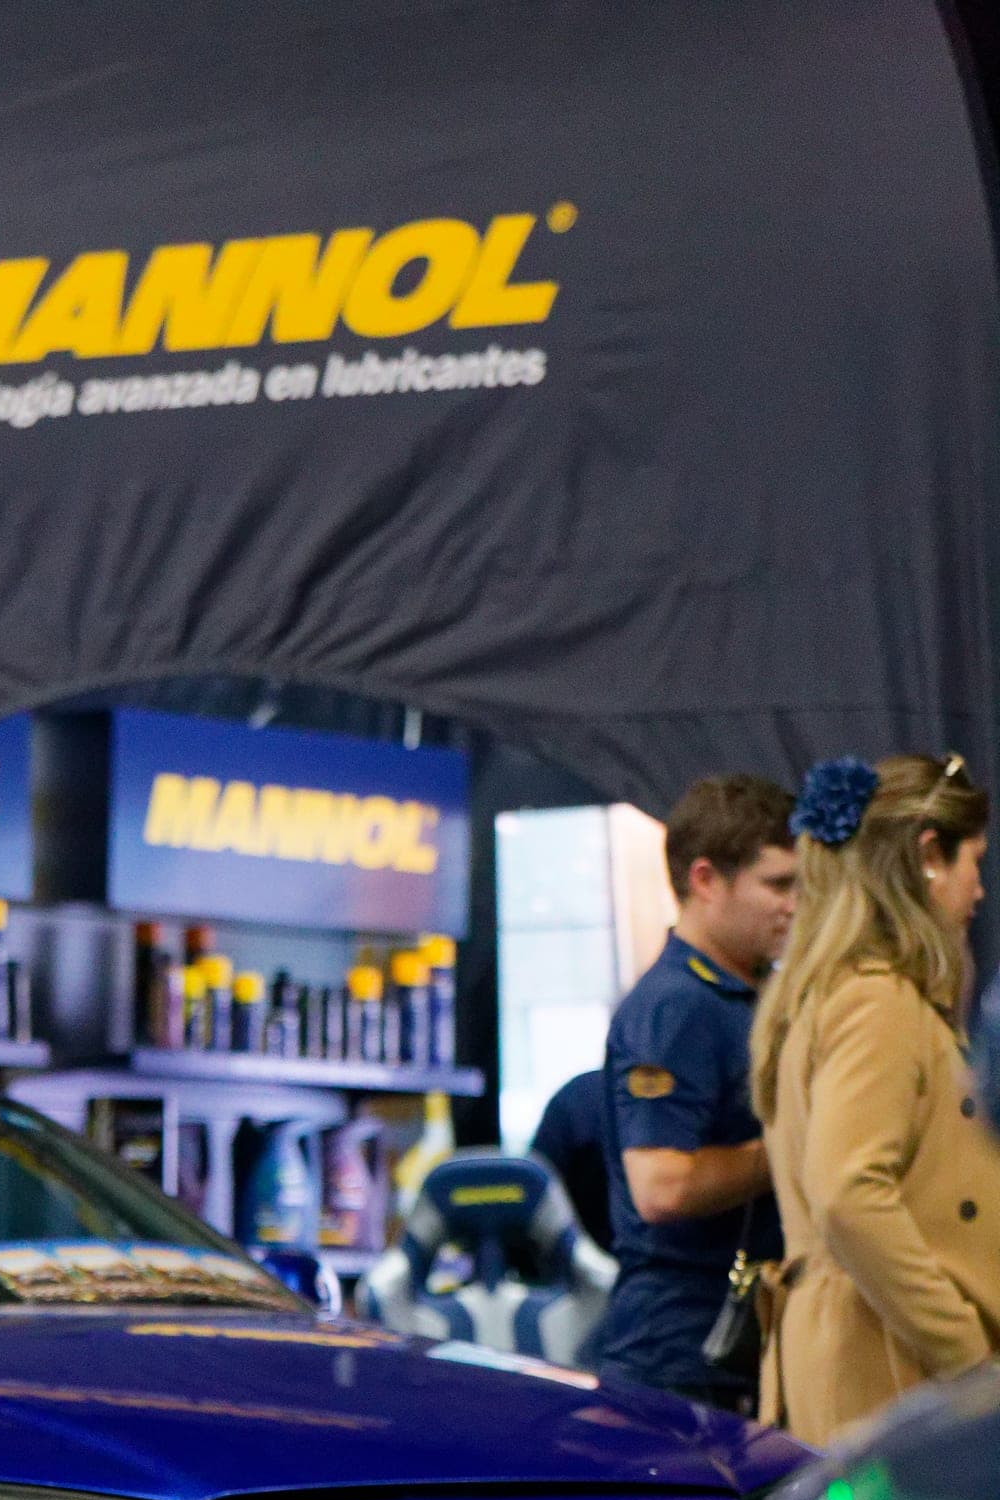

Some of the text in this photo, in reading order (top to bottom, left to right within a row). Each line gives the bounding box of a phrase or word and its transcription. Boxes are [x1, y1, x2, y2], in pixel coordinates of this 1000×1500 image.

[77, 359, 261, 416] avanzada
[264, 364, 320, 402] en
[322, 344, 548, 399] lubricantes
[143, 772, 438, 875] MANNOL
